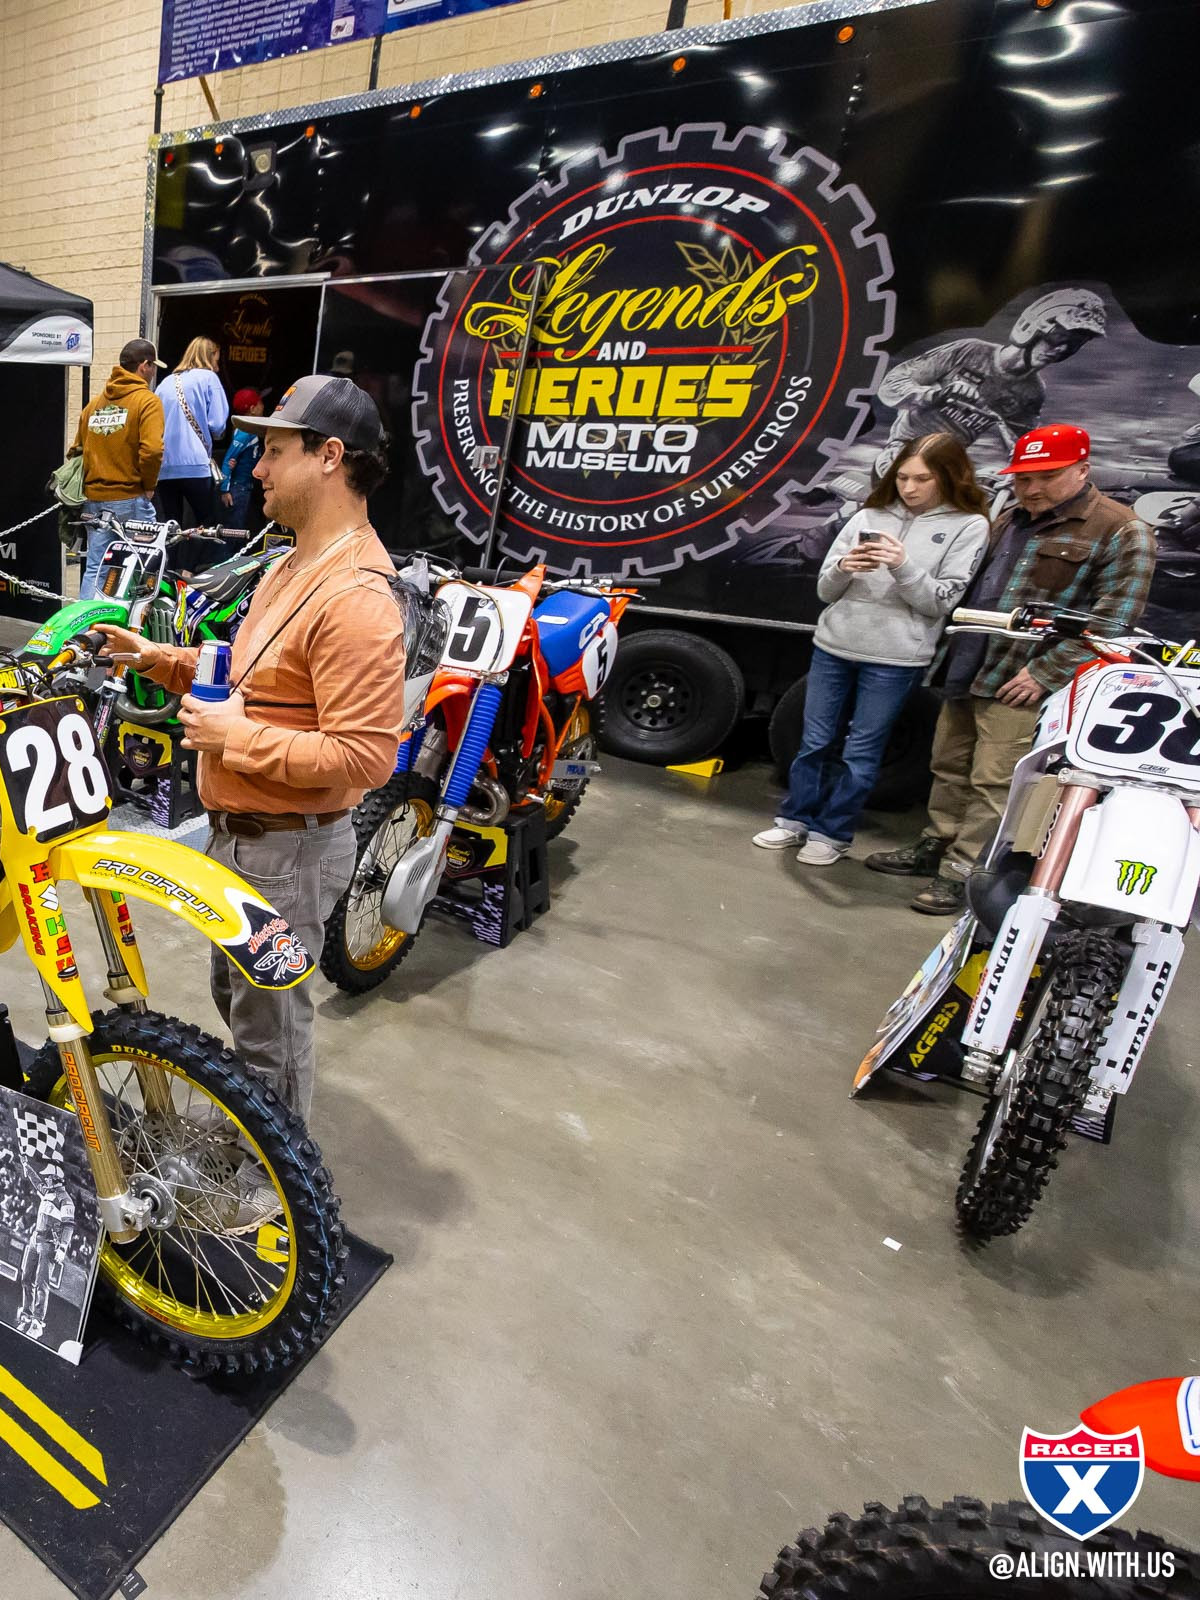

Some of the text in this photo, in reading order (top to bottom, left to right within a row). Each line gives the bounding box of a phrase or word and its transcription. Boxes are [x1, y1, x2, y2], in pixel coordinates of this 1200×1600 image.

[559, 183, 770, 241] DUNLOP
[464, 243, 819, 362] Legends
[596, 342, 647, 361] AND
[92, 416, 122, 424] ARIAT
[488, 364, 757, 418] HEROES
[508, 486, 546, 519] THE
[547, 508, 649, 533] HISTORY
[653, 497, 689, 524] OF
[691, 375, 813, 509] SUPERCROSS
[525, 453, 692, 474] MUSEUM
[526, 422, 699, 452] MOTO
[125, 521, 165, 532] RENTHA
[448, 596, 491, 662] 5
[596, 635, 609, 691] 5
[6, 713, 109, 834] 28
[18, 882, 46, 956] BRAKING
[92, 858, 141, 876] PRO
[138, 871, 224, 922] CIRCUIT
[974, 927, 1020, 1034] DUNLOP
[1120, 961, 1172, 1080] DUNLOP
[110, 1044, 187, 1075] DUNLOP
